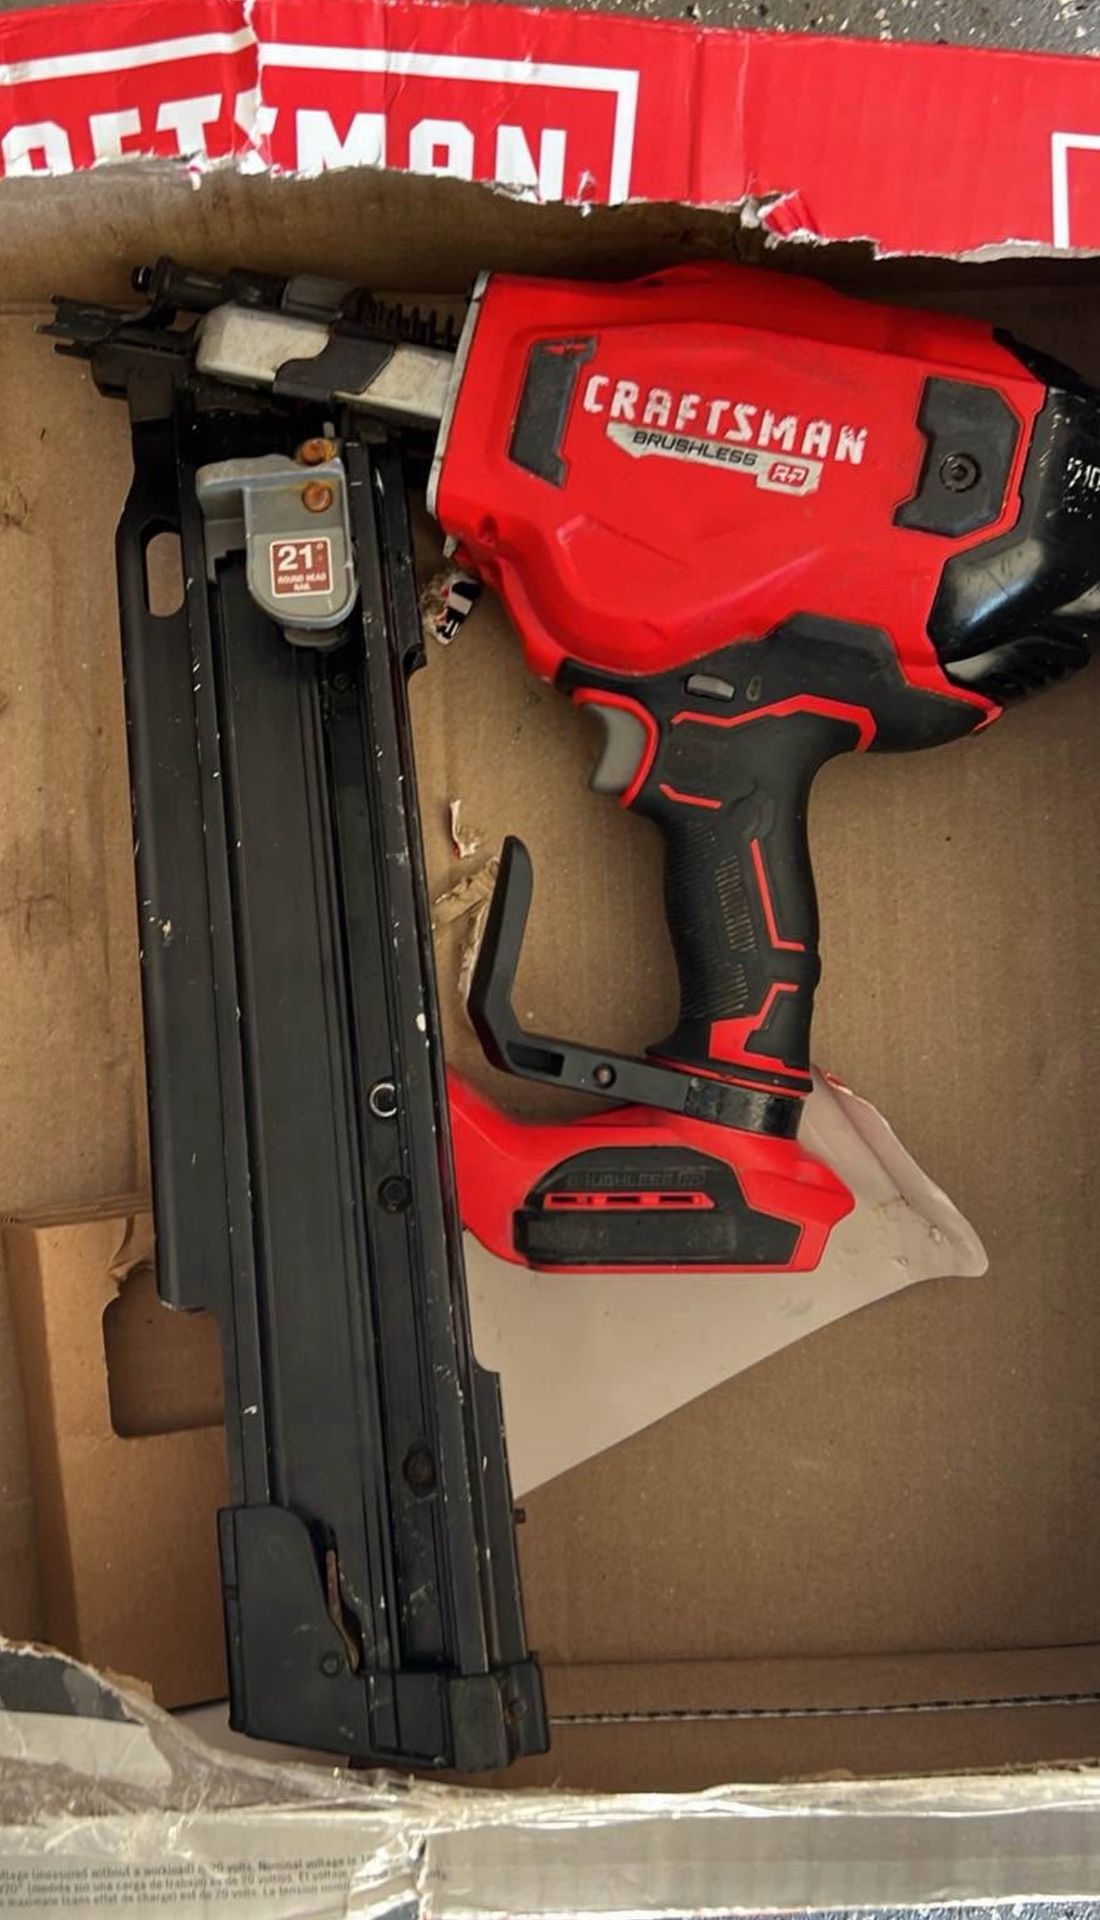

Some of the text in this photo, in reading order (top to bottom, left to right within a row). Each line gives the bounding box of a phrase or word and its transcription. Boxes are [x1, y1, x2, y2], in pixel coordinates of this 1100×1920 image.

[583, 374, 868, 465] CRAFTSMAN
[632, 431, 758, 467] BRUSHLESS
[277, 572, 327, 584] ROUND HEAD
[91, 1865, 129, 1878] without
[258, 1859, 302, 1872] Nominal
[305, 1856, 345, 1870] voltage
